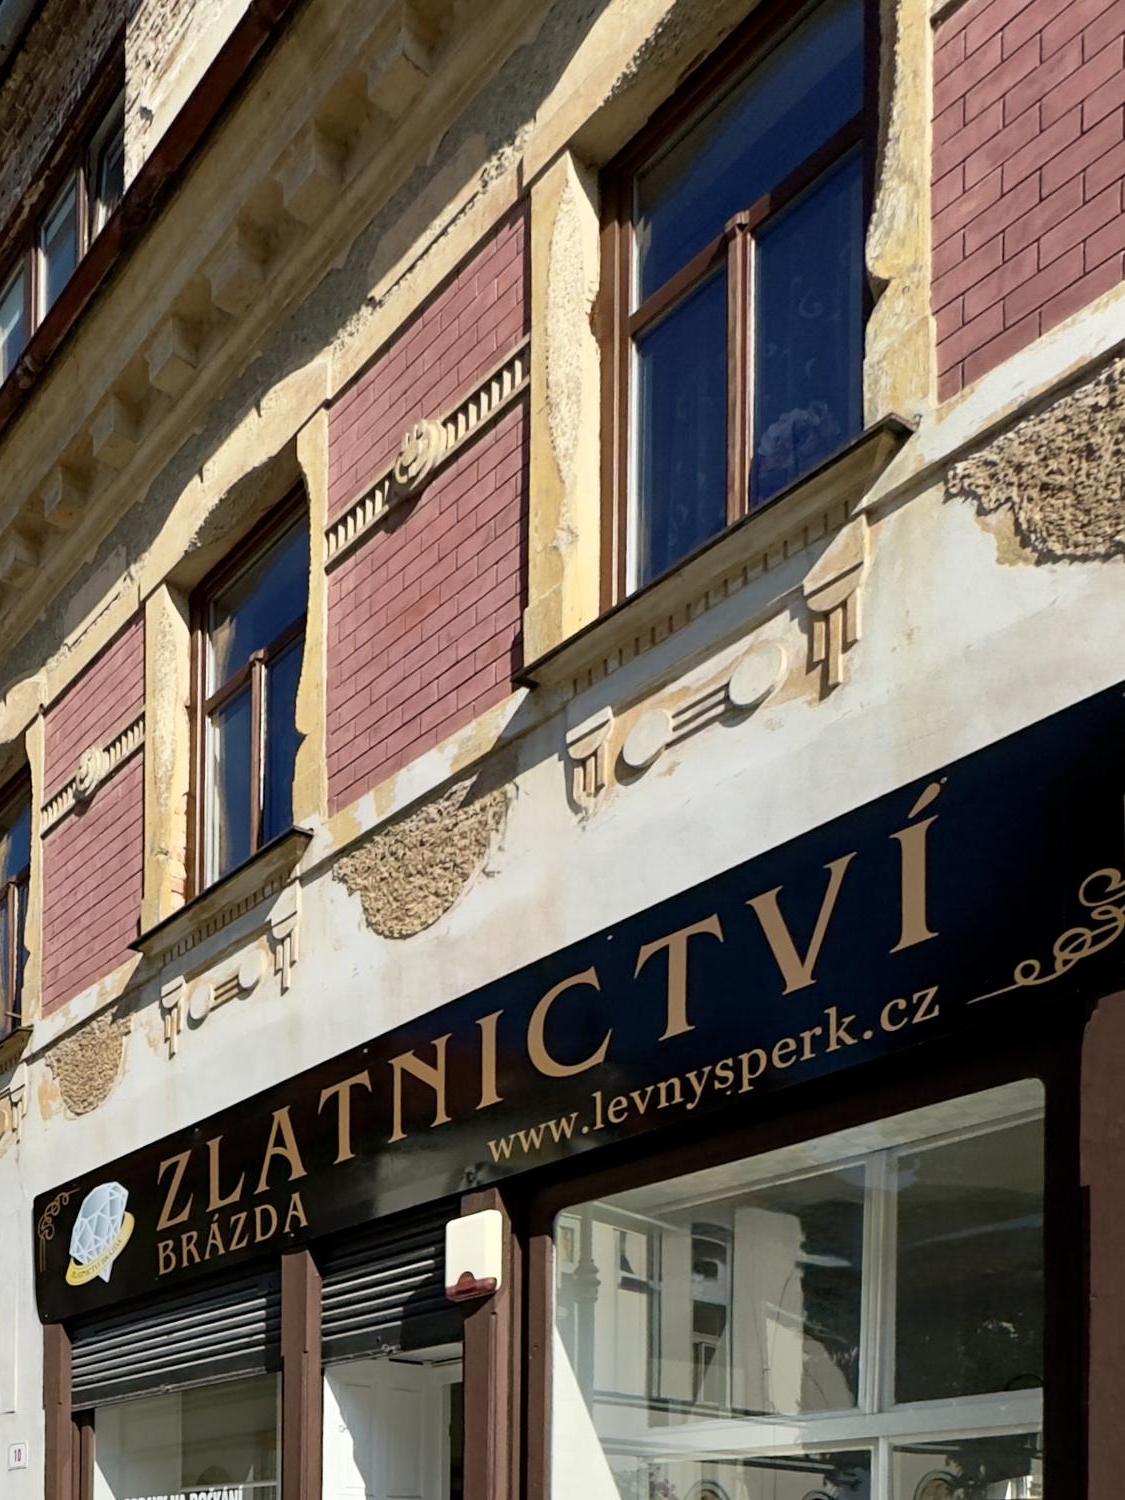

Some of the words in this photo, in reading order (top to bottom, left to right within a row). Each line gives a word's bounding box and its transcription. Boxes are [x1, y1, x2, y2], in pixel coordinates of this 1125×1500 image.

[156, 780, 939, 1231] ZLATNICTVÍ
[487, 985, 940, 1163] www.levnysperk.cz
[157, 1192, 308, 1275] BRÁZDA
